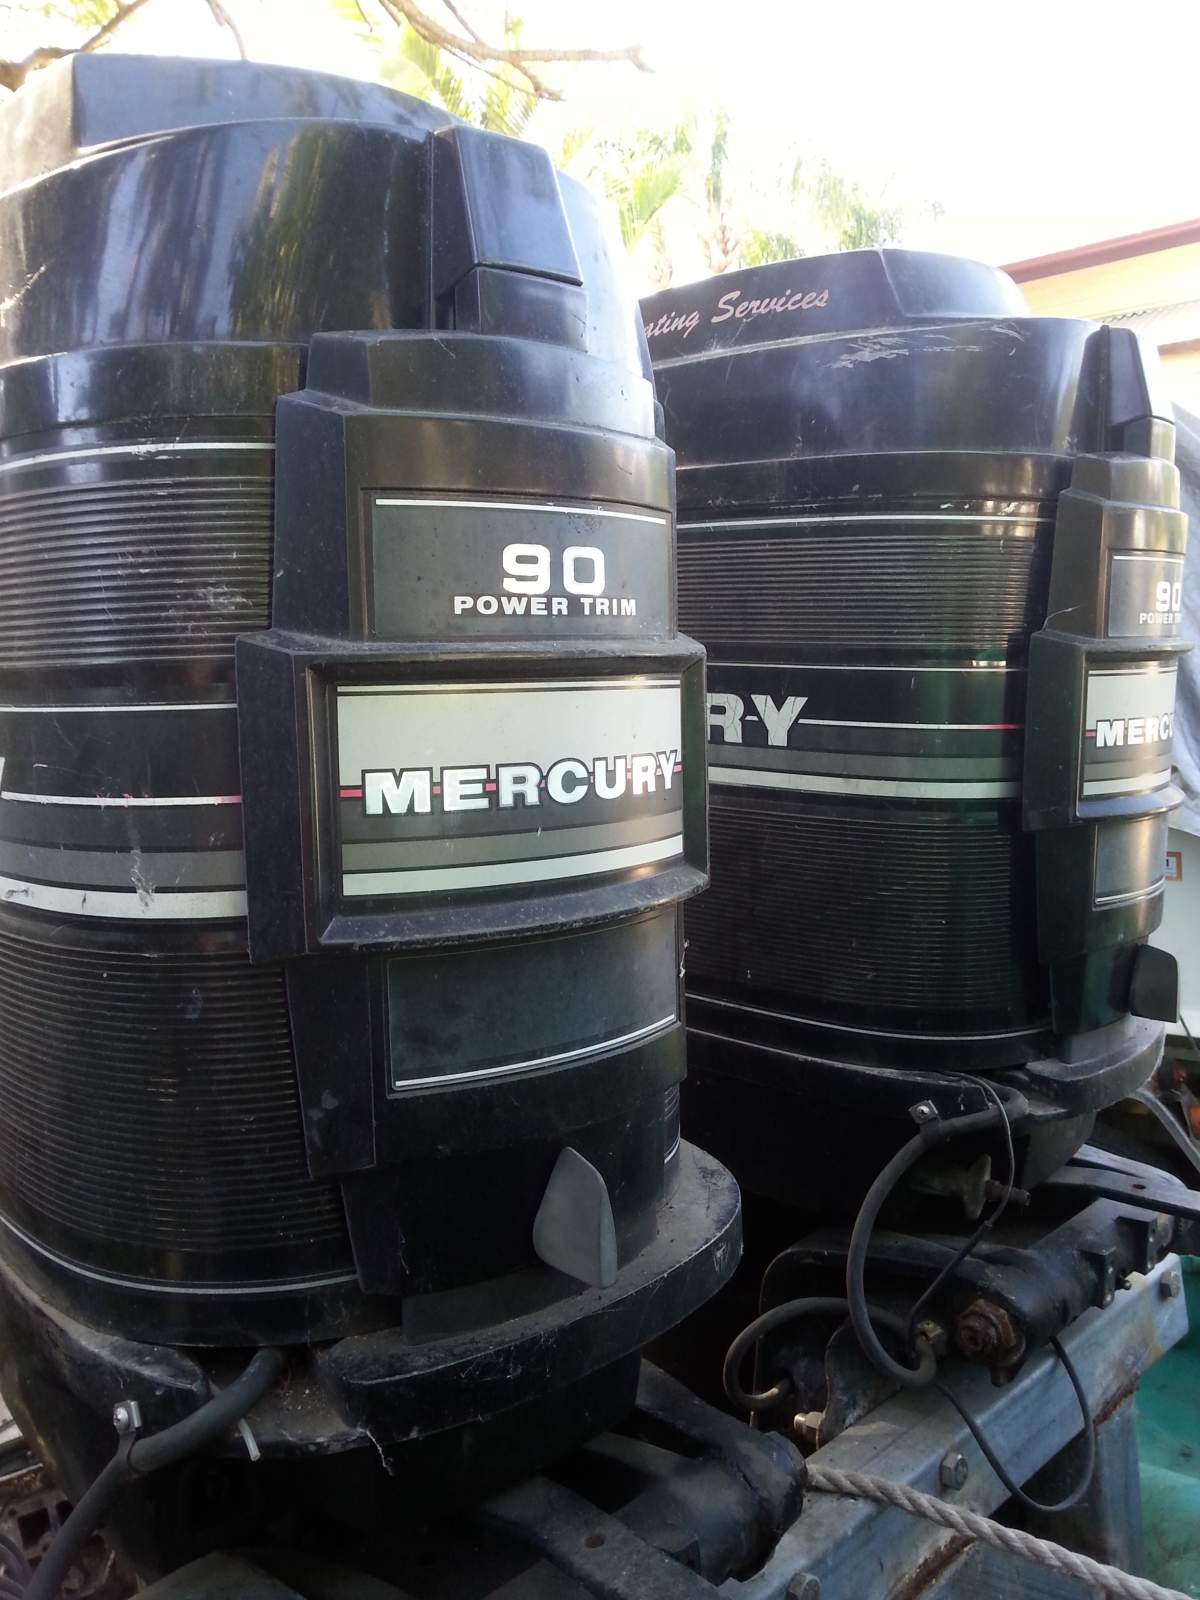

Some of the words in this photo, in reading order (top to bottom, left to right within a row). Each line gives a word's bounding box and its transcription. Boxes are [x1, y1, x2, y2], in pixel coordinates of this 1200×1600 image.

[711, 288, 830, 324] Services
[502, 543, 606, 596] 90
[454, 595, 569, 616] POWER
[580, 597, 637, 616] TRIM
[1156, 581, 1182, 611] 90
[361, 749, 678, 817] MERCURY
